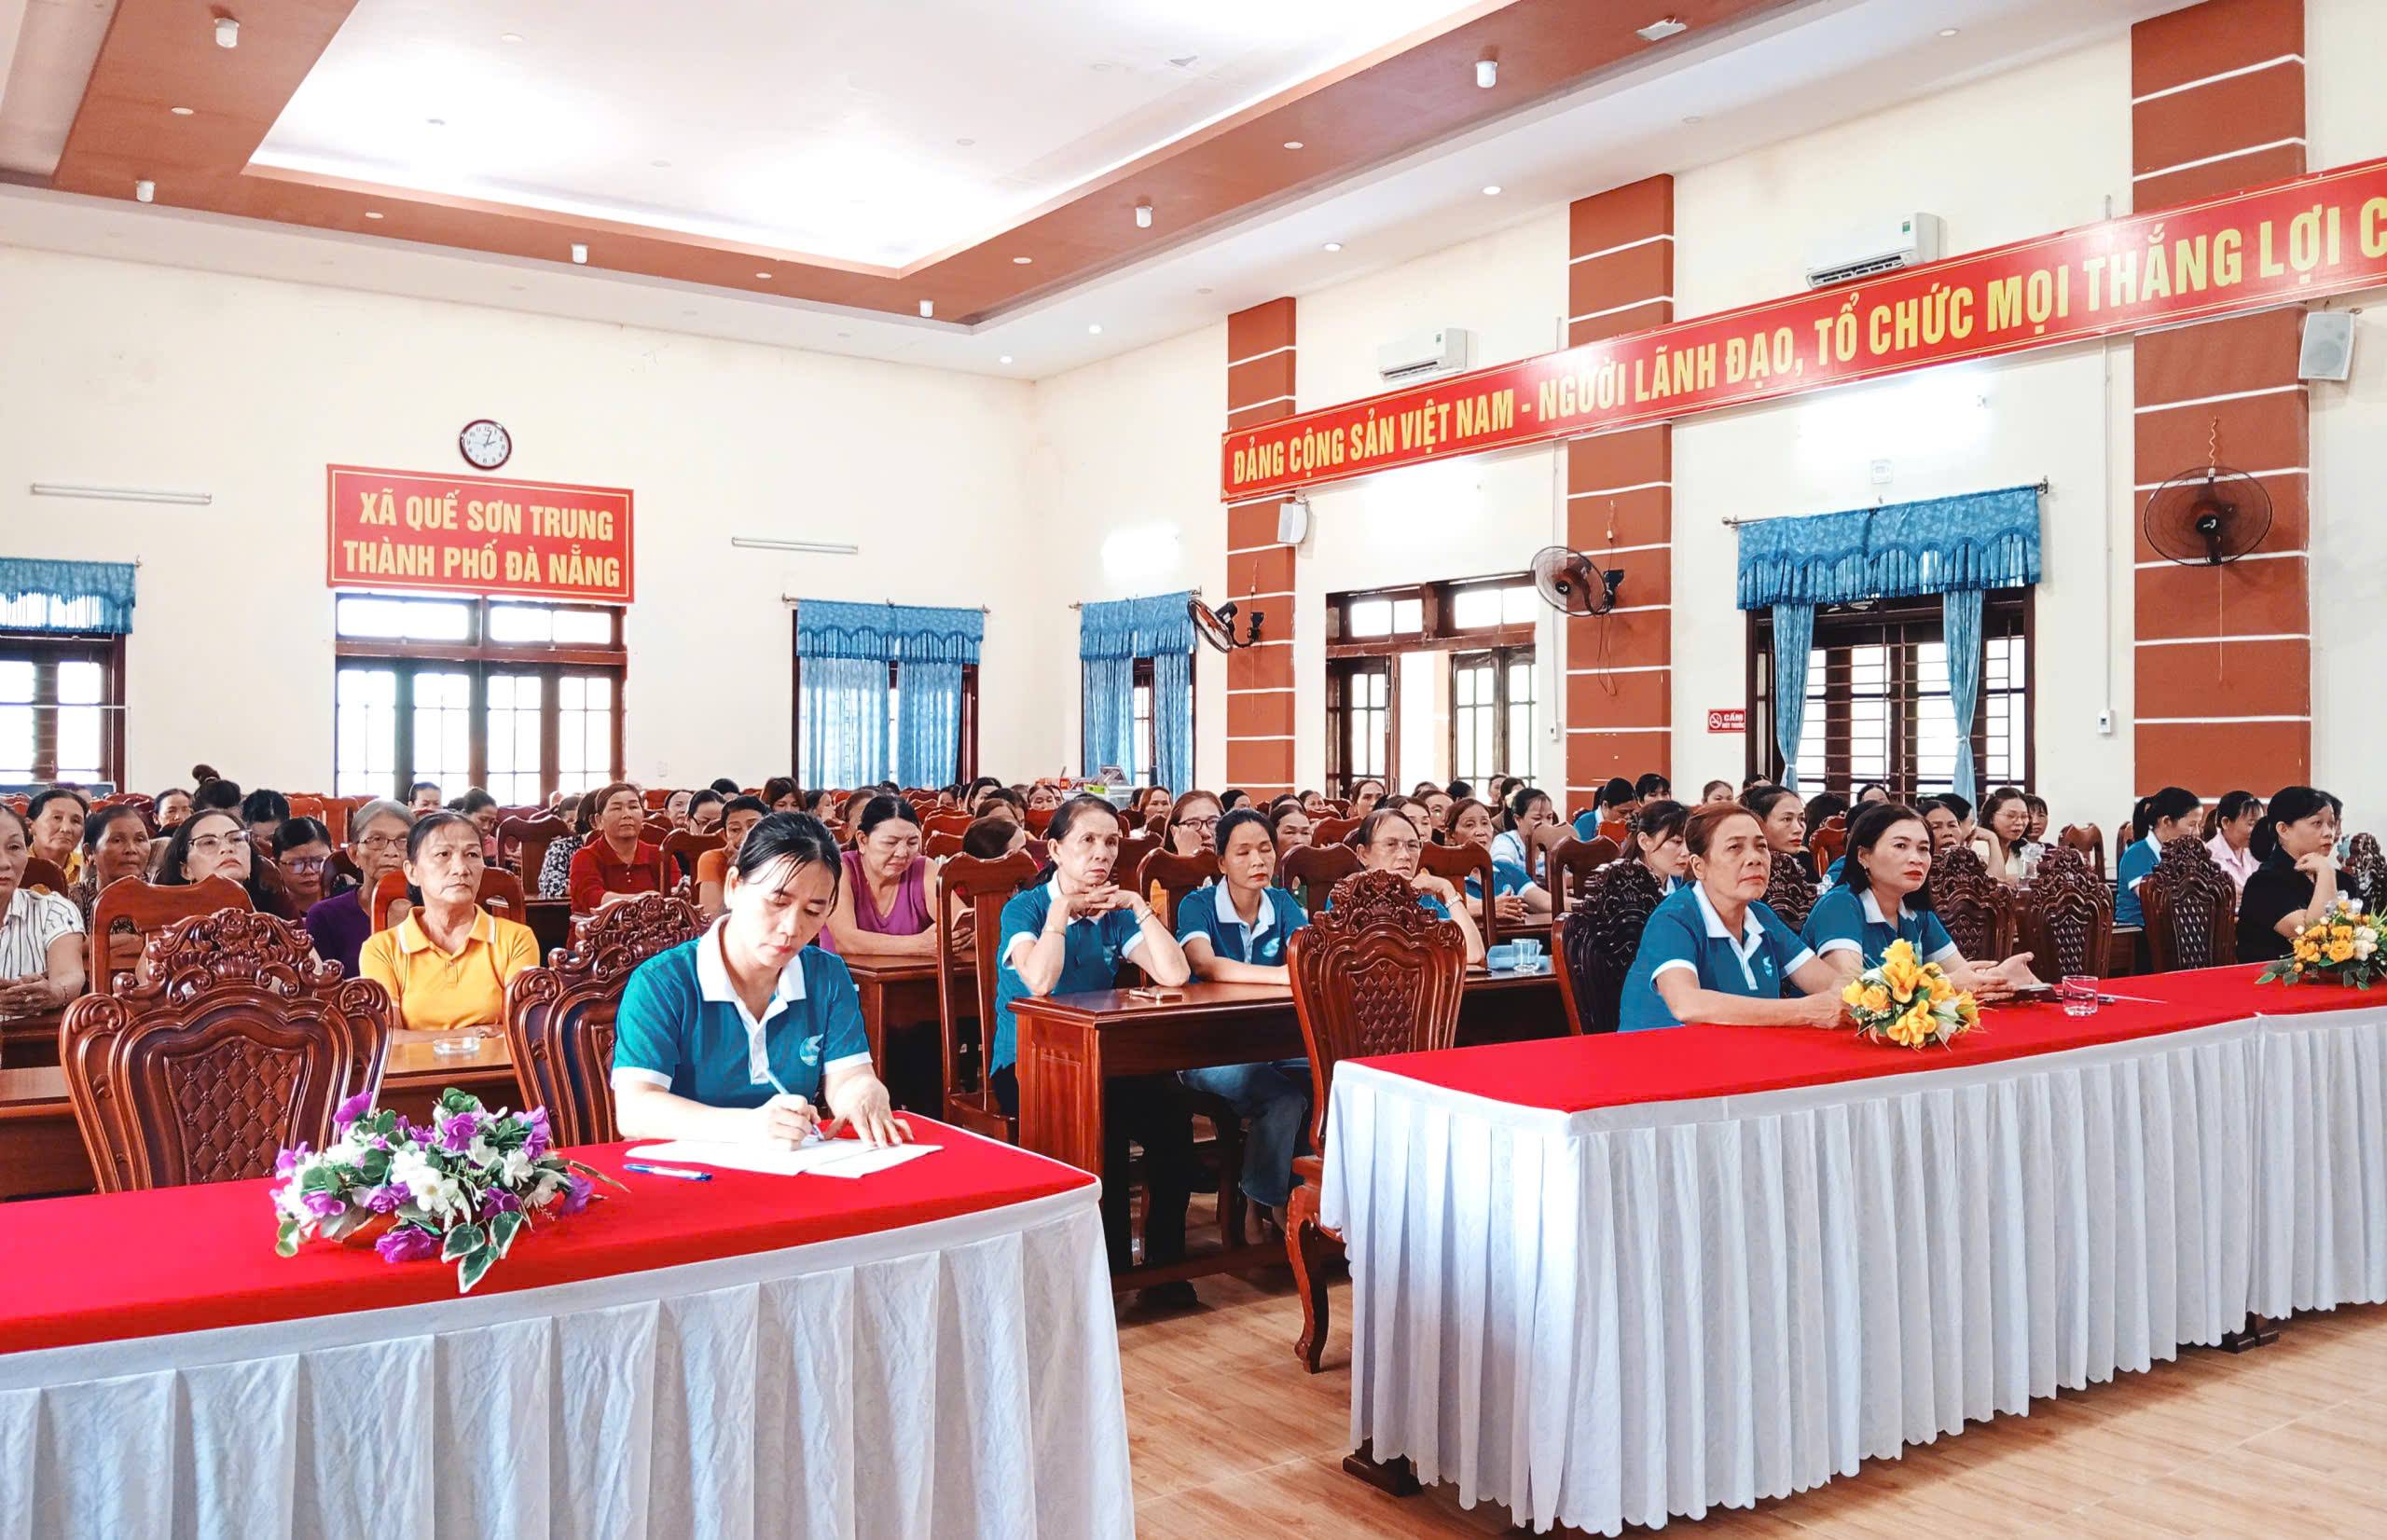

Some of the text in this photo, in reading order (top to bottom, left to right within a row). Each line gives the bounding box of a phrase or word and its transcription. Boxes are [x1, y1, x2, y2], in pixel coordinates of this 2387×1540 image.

[1234, 436, 1284, 485] ĐẢNG
[1290, 427, 1345, 477] CỘNG
[1350, 407, 1395, 461] SẢN
[1400, 399, 1450, 454] VIỆT
[1456, 389, 1514, 439] NAM
[1538, 356, 1626, 421] NGƯỜI
[1635, 345, 1717, 403] LÃNH
[1725, 327, 1803, 389] ĐẠO,
[1814, 292, 1859, 366] TỔ
[1870, 282, 1974, 355] CHỨC
[1987, 265, 2069, 335] MỌI
[2083, 223, 2242, 312] THẮNG
[2259, 203, 2341, 284] LỢI
[359, 488, 614, 542] XÃ QUẾ SƠN TRUNG
[343, 536, 620, 587] THÀNH PHỐ ĐÀ NẴNG
